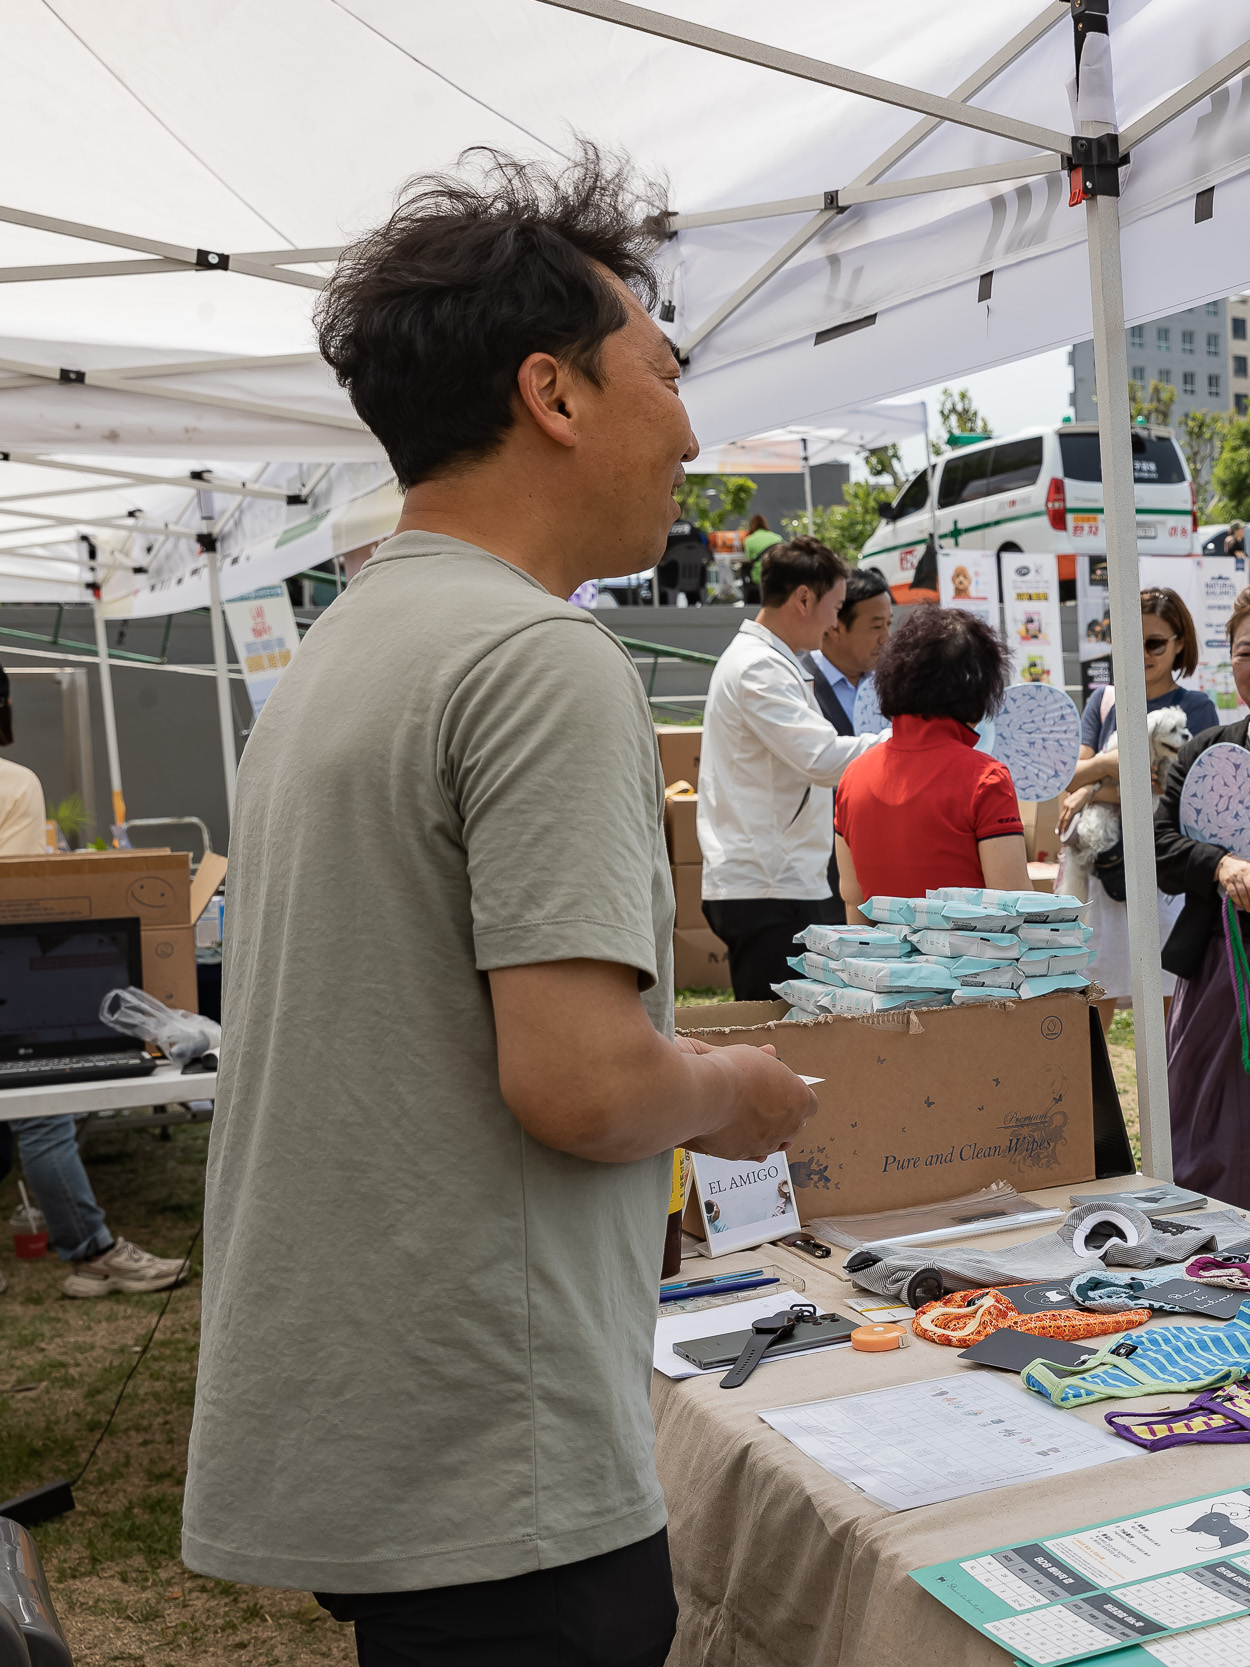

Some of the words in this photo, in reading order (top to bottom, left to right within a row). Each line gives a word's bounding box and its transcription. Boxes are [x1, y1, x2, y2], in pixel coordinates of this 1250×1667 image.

[1003, 1111, 1048, 1125] Premium
[882, 1154, 920, 1173] Pure
[925, 1146, 955, 1166] and
[959, 1142, 1002, 1162] Clean
[1007, 1136, 1052, 1157] Wipes
[708, 1180, 726, 1195] EL
[729, 1166, 778, 1189] AMIGO
[1034, 1557, 1052, 1568] BDB
[1047, 1567, 1068, 1579] 베이직
